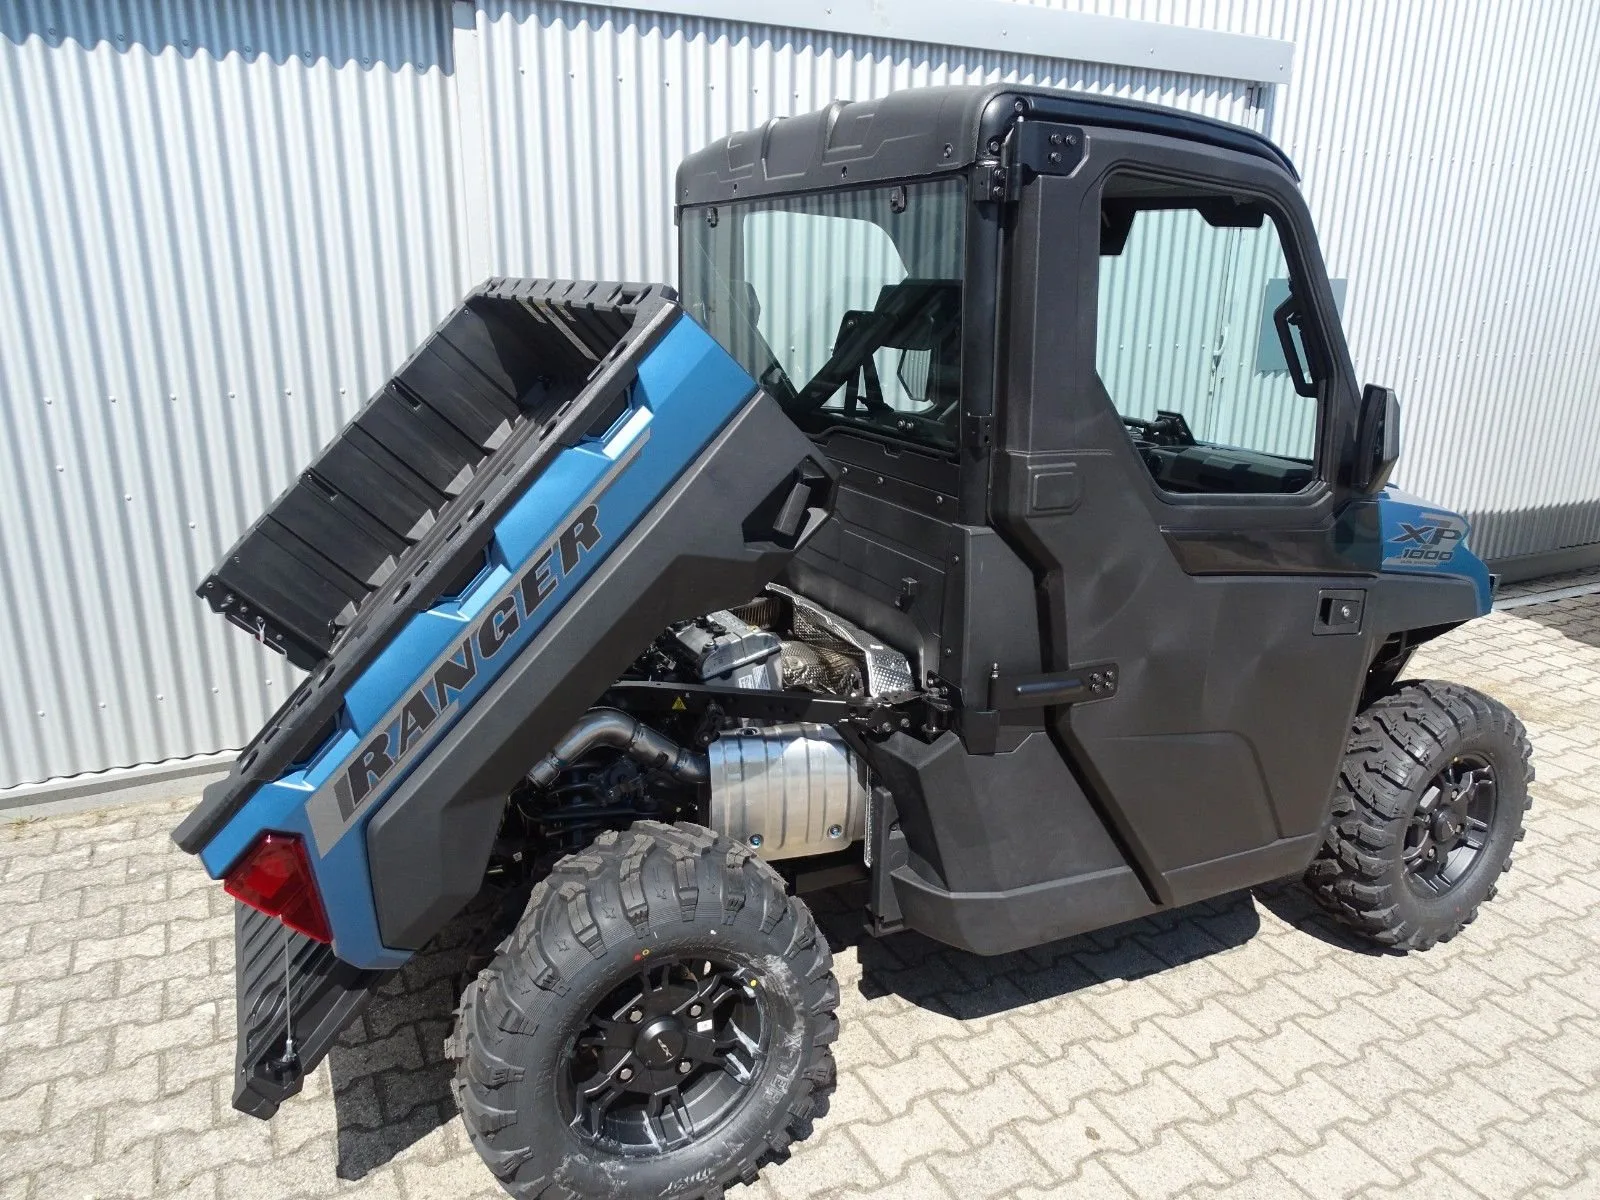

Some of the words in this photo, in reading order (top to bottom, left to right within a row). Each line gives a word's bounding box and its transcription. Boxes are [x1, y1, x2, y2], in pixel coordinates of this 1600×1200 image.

[1390, 522, 1463, 546] XP
[1401, 548, 1453, 560] 1000
[347, 503, 603, 809] RANGER
